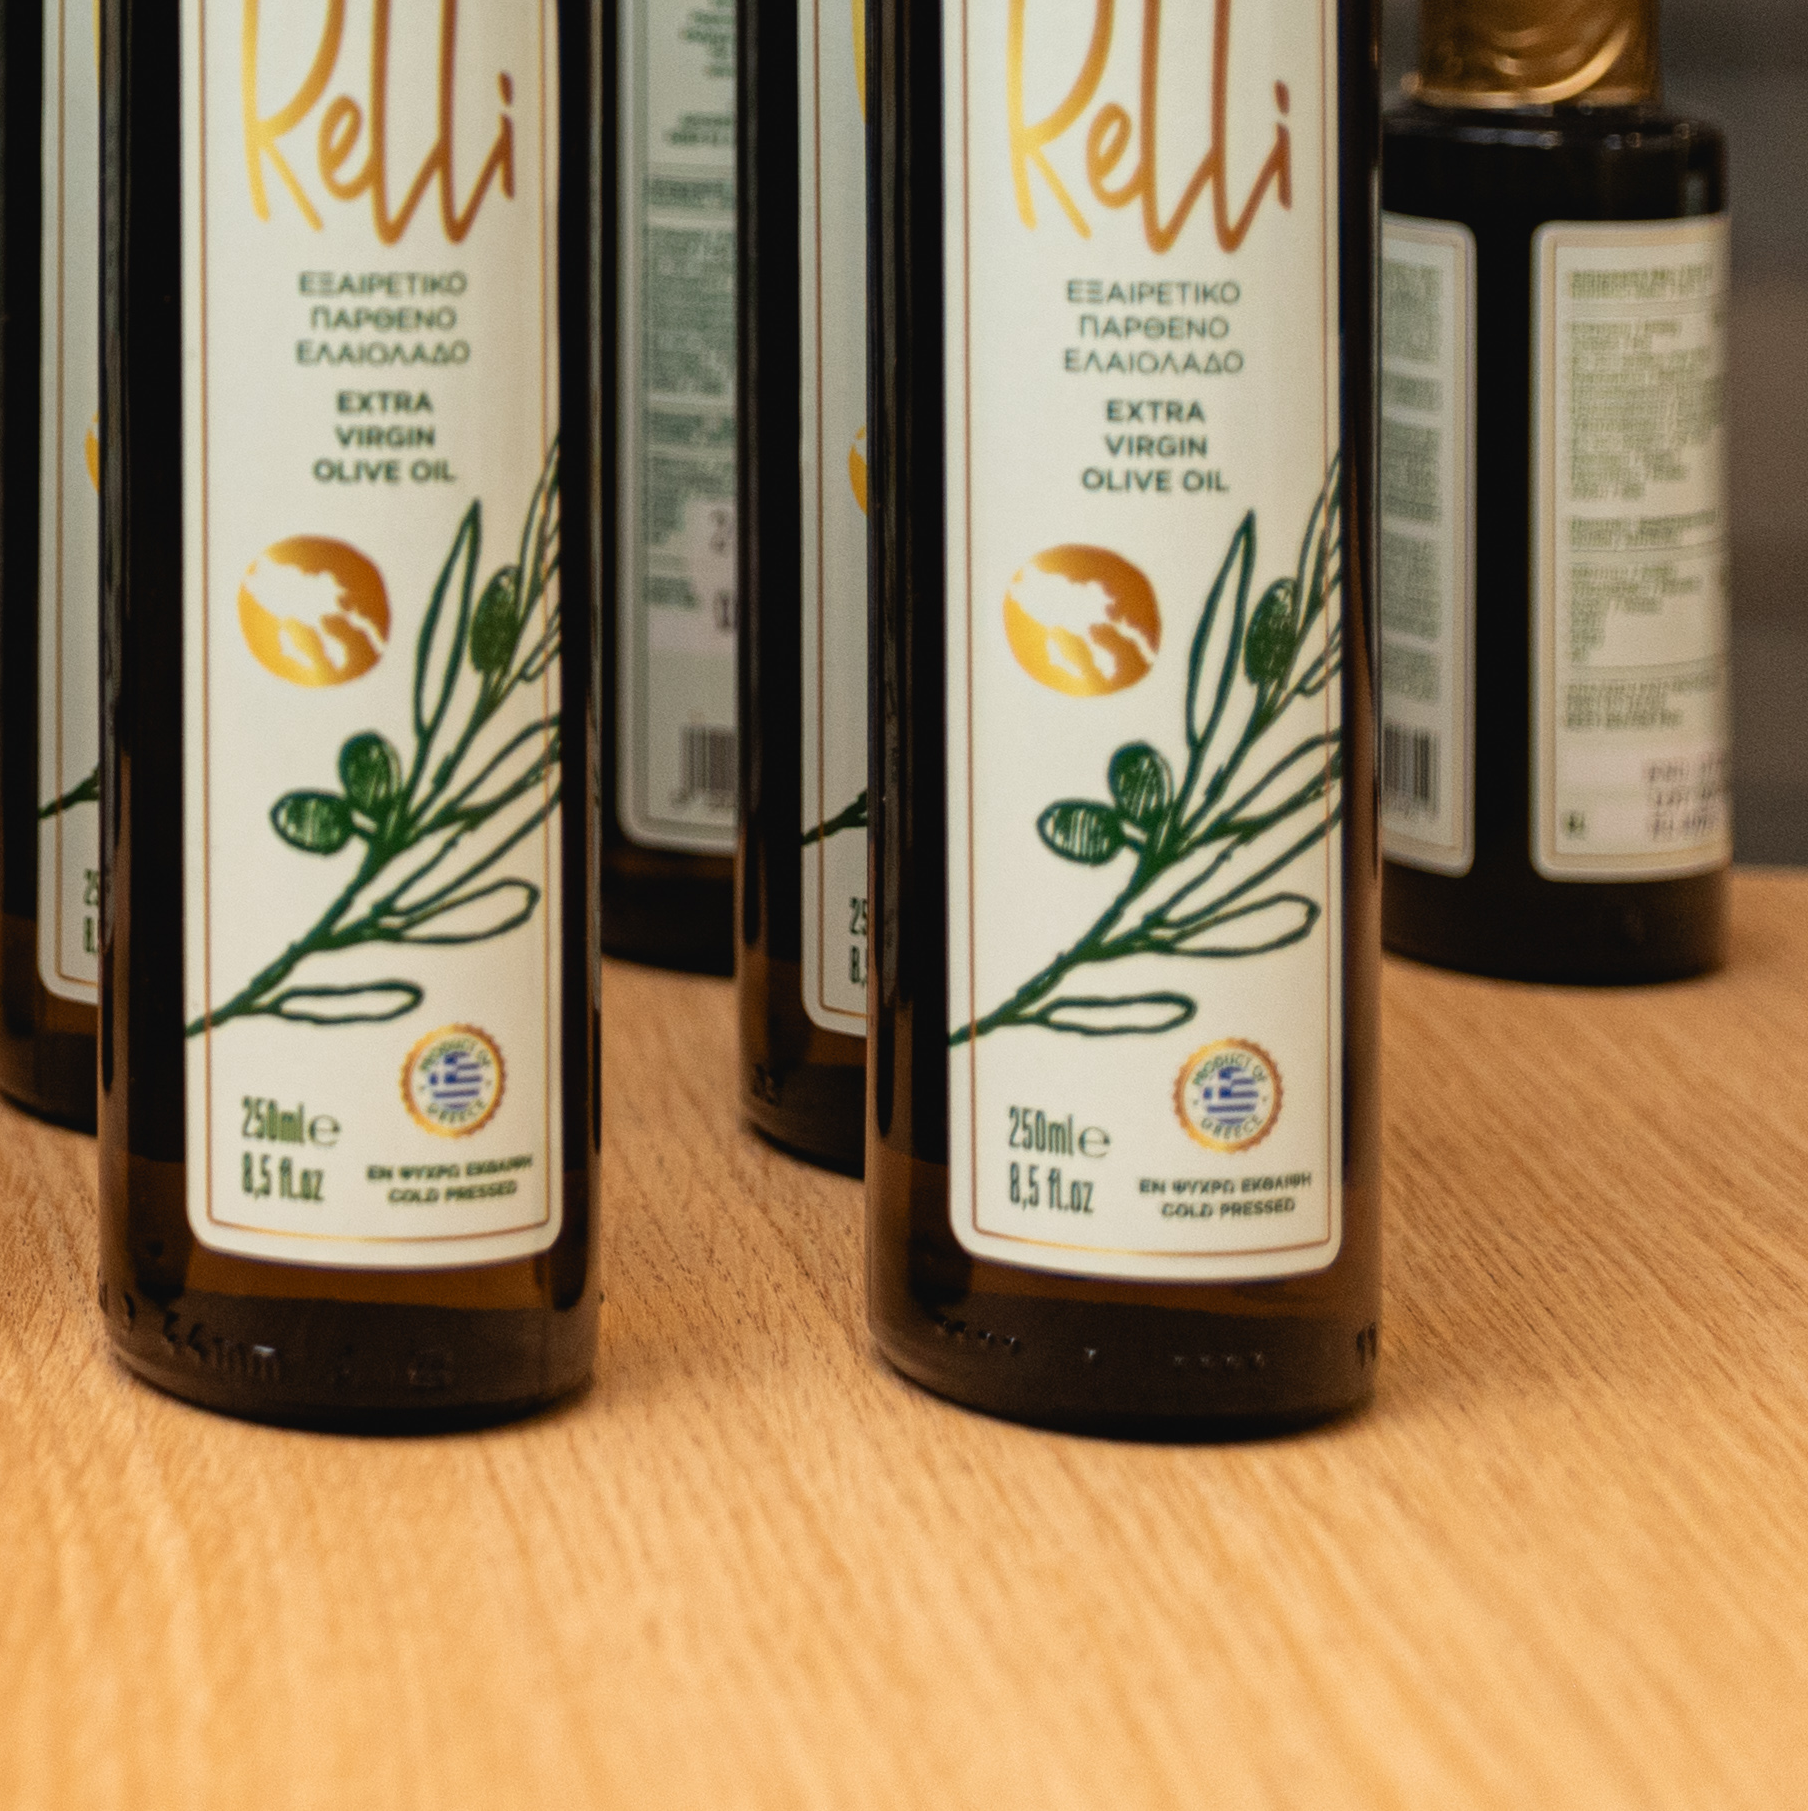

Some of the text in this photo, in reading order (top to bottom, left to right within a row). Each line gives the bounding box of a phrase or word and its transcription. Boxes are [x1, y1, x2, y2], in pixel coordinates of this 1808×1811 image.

[1067, 279, 1240, 306] ΕΞΑΙΡΕΤΙΚΟ
[1080, 314, 1229, 340] ΠΑΡΘΕΝΟ
[1063, 348, 1244, 374] ΕΛΑΙΟΛΑΔΟ
[336, 390, 433, 415] EXTRA
[1106, 399, 1205, 423] EXTRA
[335, 424, 435, 449] VIRGIN
[1104, 434, 1208, 458] VIRGIN
[313, 458, 457, 485] OLIVE OIL
[1082, 467, 1229, 492] OLIVE OIL
[1009, 1106, 1074, 1157] 250ml
[1010, 1161, 1039, 1211] 8,5
[1161, 1197, 1295, 1218] COLD PRESSED
